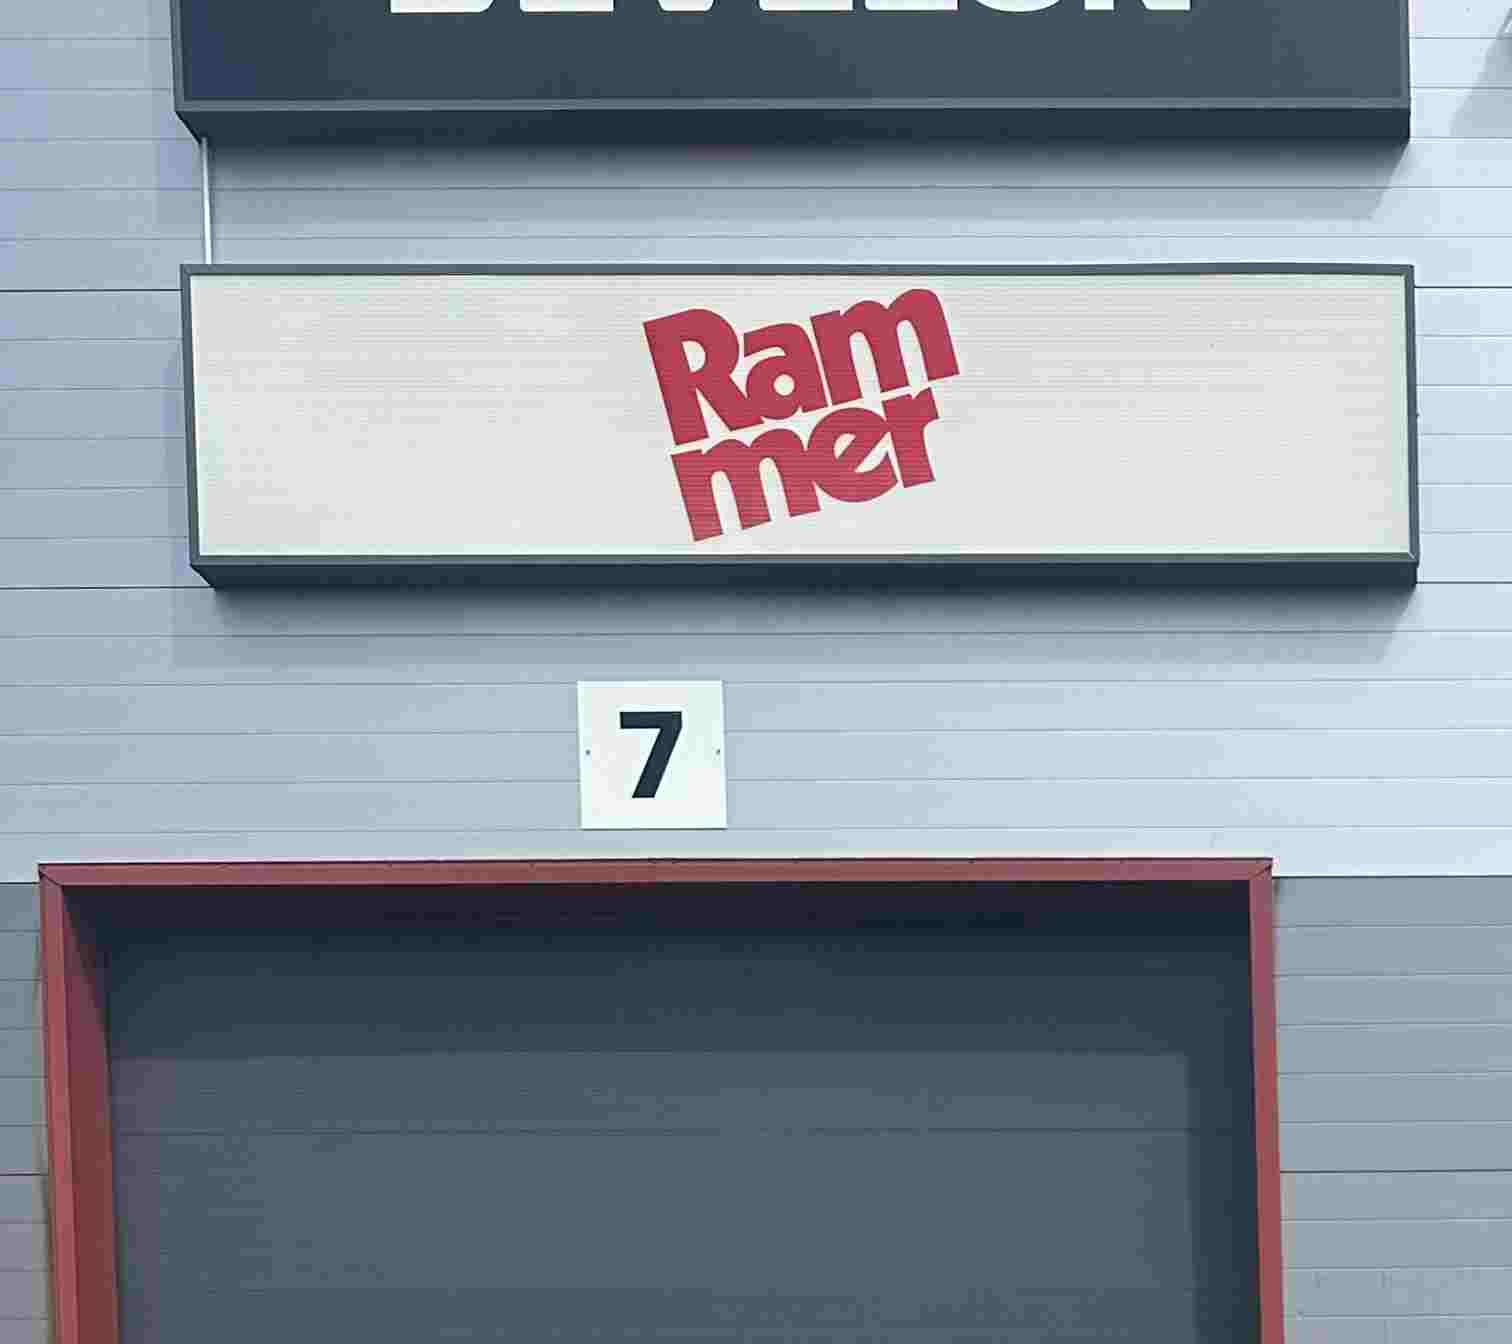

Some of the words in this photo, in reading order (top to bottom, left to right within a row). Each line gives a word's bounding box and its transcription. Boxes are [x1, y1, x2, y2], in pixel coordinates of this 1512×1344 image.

[644, 288, 961, 445] Ram
[671, 388, 940, 542] mer
[619, 711, 683, 799] 7
